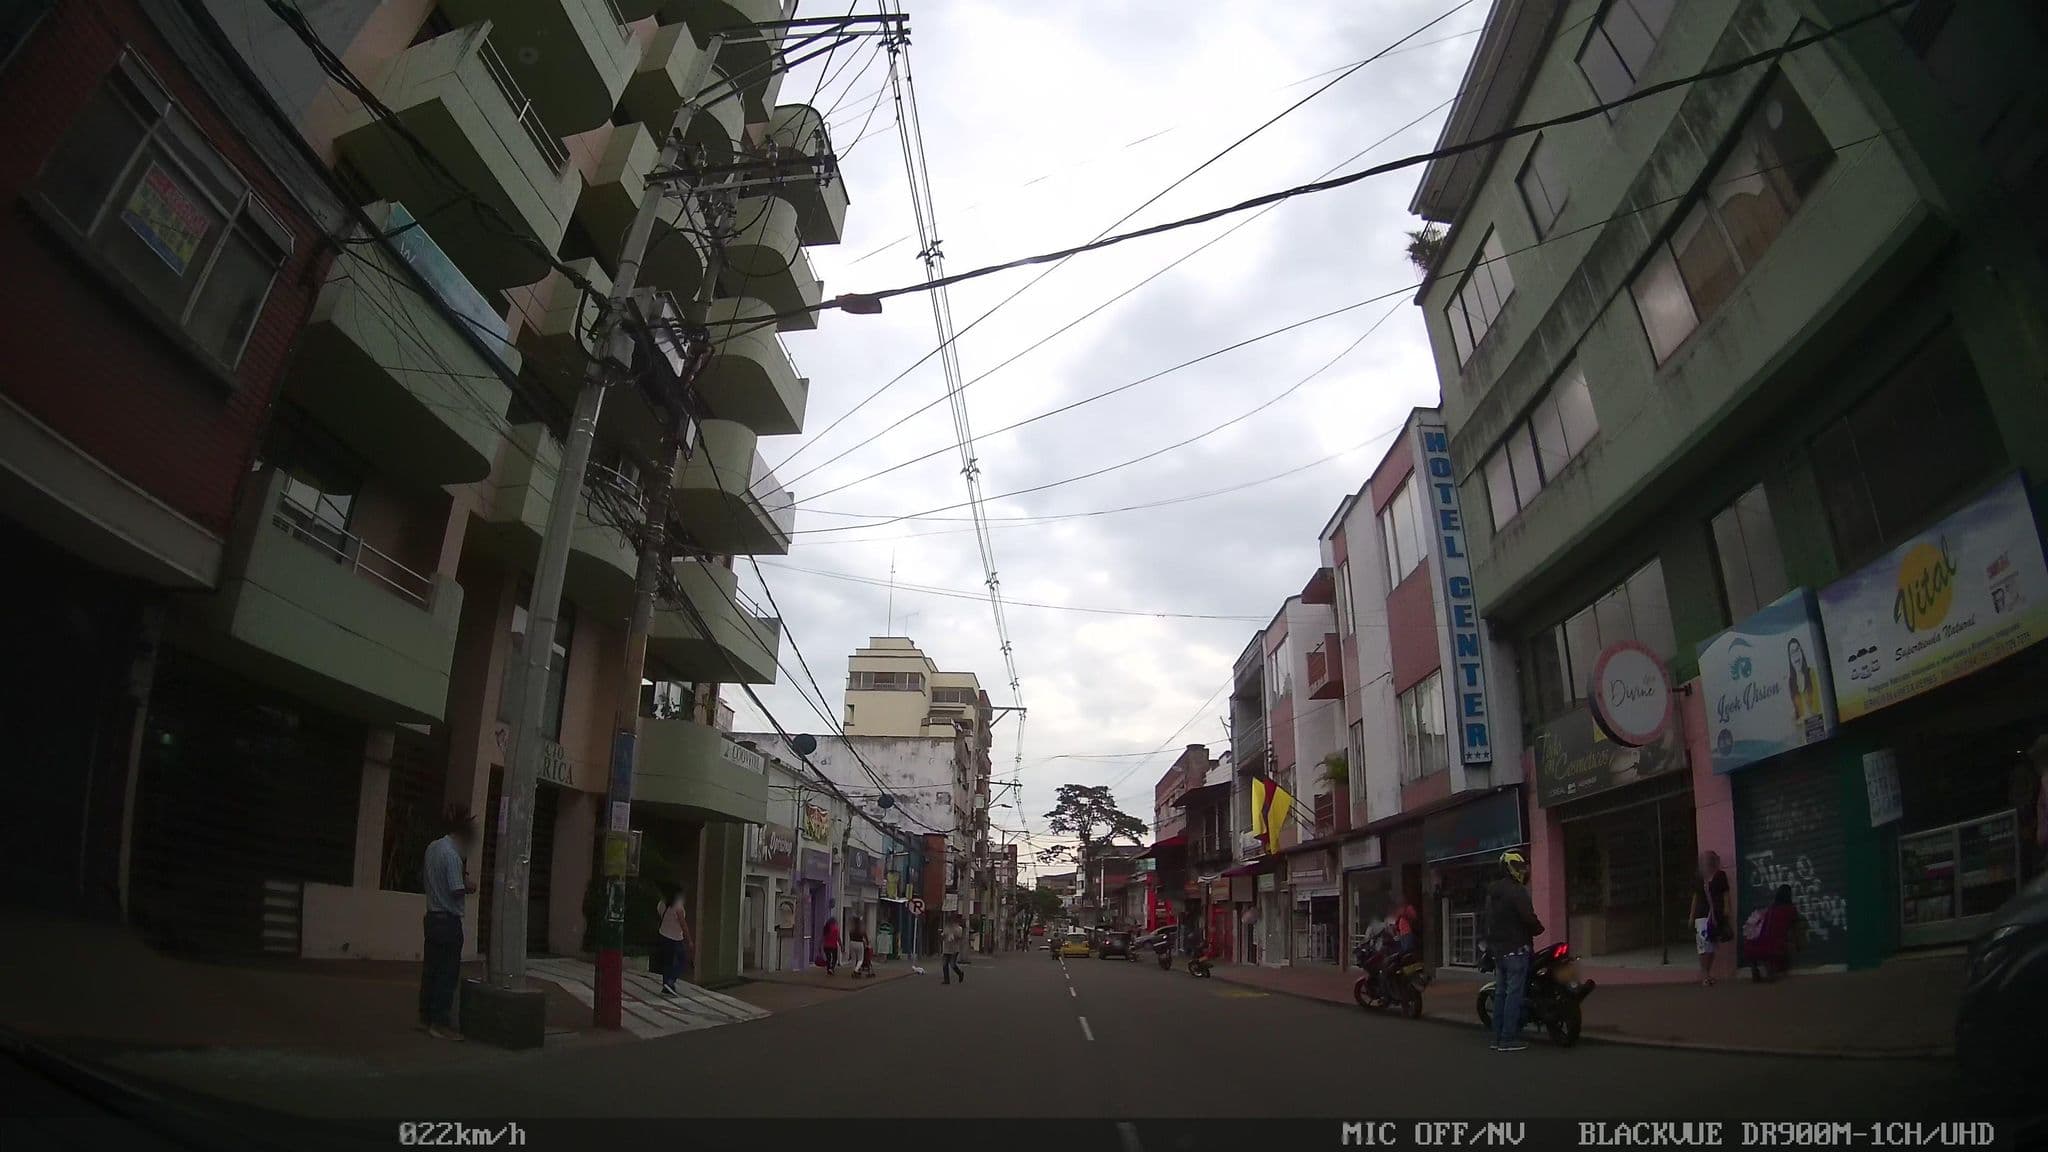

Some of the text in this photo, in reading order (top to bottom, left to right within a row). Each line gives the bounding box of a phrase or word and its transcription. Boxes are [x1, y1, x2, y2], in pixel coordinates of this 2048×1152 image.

[1424, 431, 1488, 748] HOTEL CENTER
[1893, 535, 1956, 632] Vital
[1610, 680, 1655, 707] Divine
[544, 744, 564, 758] CIO
[542, 756, 574, 785] RICA
